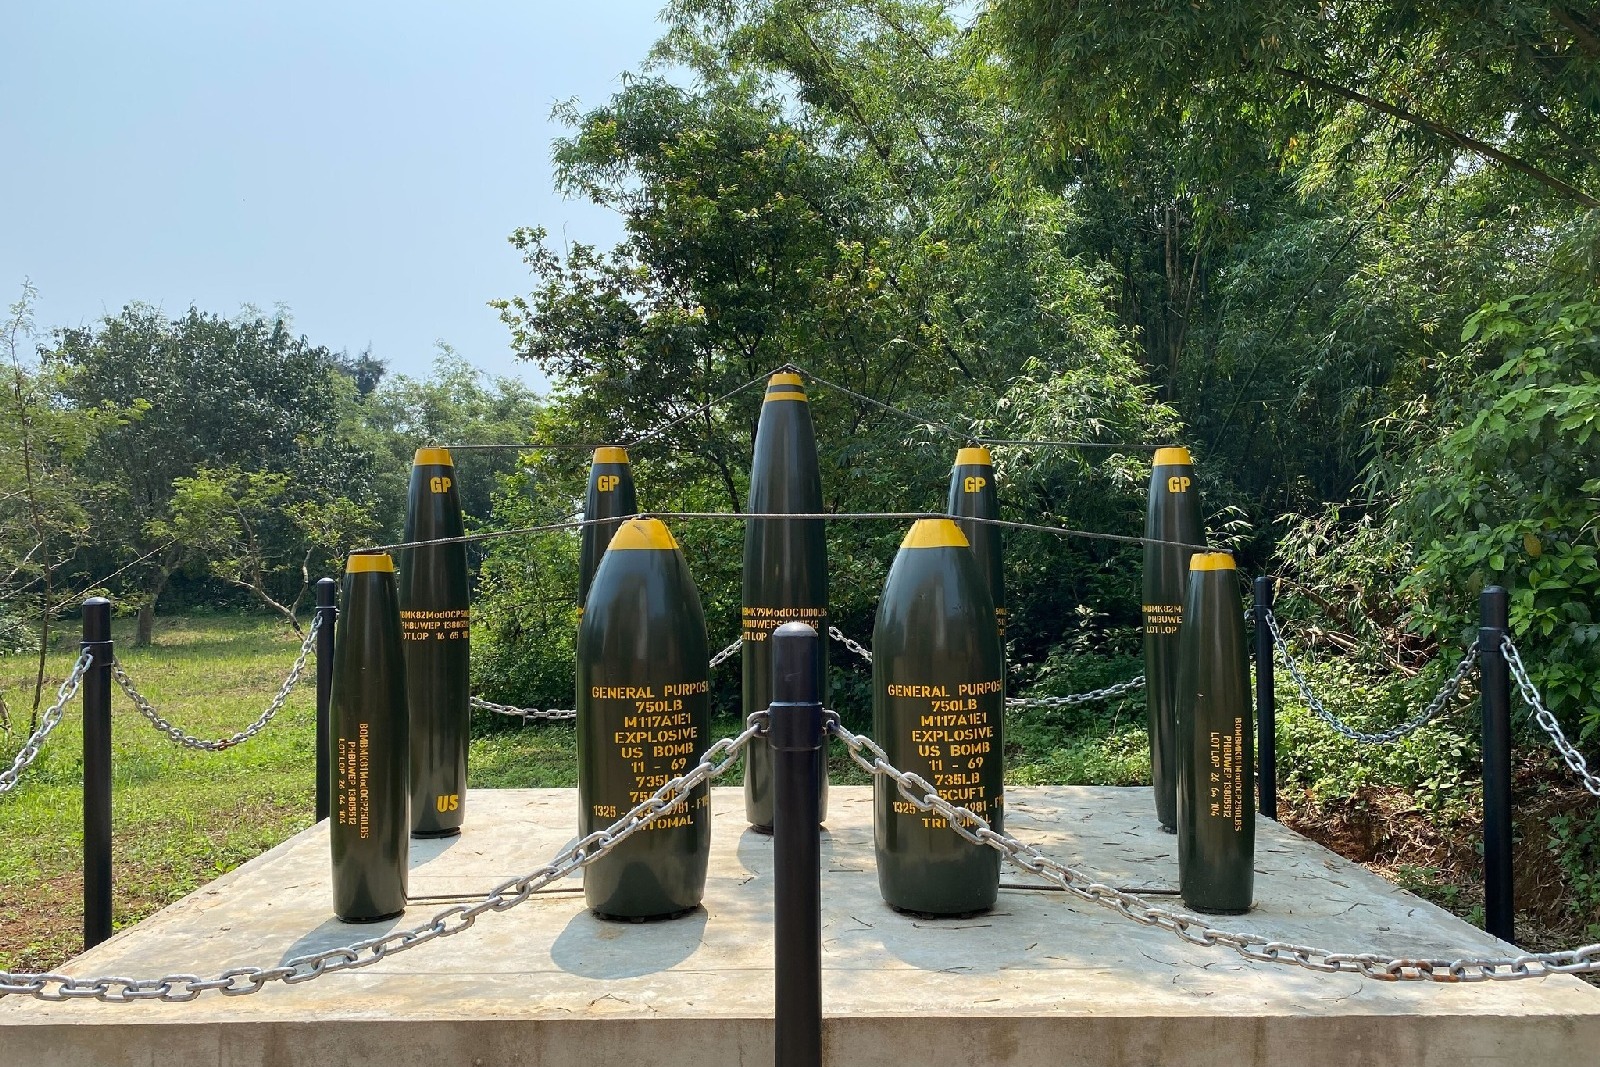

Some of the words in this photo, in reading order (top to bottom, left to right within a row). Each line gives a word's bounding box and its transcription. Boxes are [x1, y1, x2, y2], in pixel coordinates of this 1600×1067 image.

[429, 476, 452, 494] GP
[597, 475, 620, 492] GP
[963, 476, 987, 493] GP
[1168, 476, 1192, 493] GP
[592, 686, 656, 699] GENERAL
[887, 684, 951, 698] GENERAL
[635, 699, 683, 714] 750LB
[931, 699, 978, 713] 750LB
[624, 712, 691, 728] M117A1E1
[921, 712, 987, 727] M117A1E1
[614, 726, 698, 743] EXPLOSIVE
[911, 726, 994, 742] EXPLOSIVE
[621, 747, 644, 758] US
[653, 742, 694, 757] BOMB
[918, 745, 941, 757] US
[950, 742, 990, 757] BOMB
[1223, 735, 1232, 779] PHBUWEP
[348, 741, 357, 785] PHBUWEP
[631, 761, 645, 773] 11
[671, 758, 687, 770] 69
[928, 760, 942, 771] 11
[967, 757, 984, 769] 69
[934, 772, 980, 786] 735LB
[437, 794, 459, 812] US
[892, 801, 916, 815] 1325
[594, 804, 616, 818] 1325
